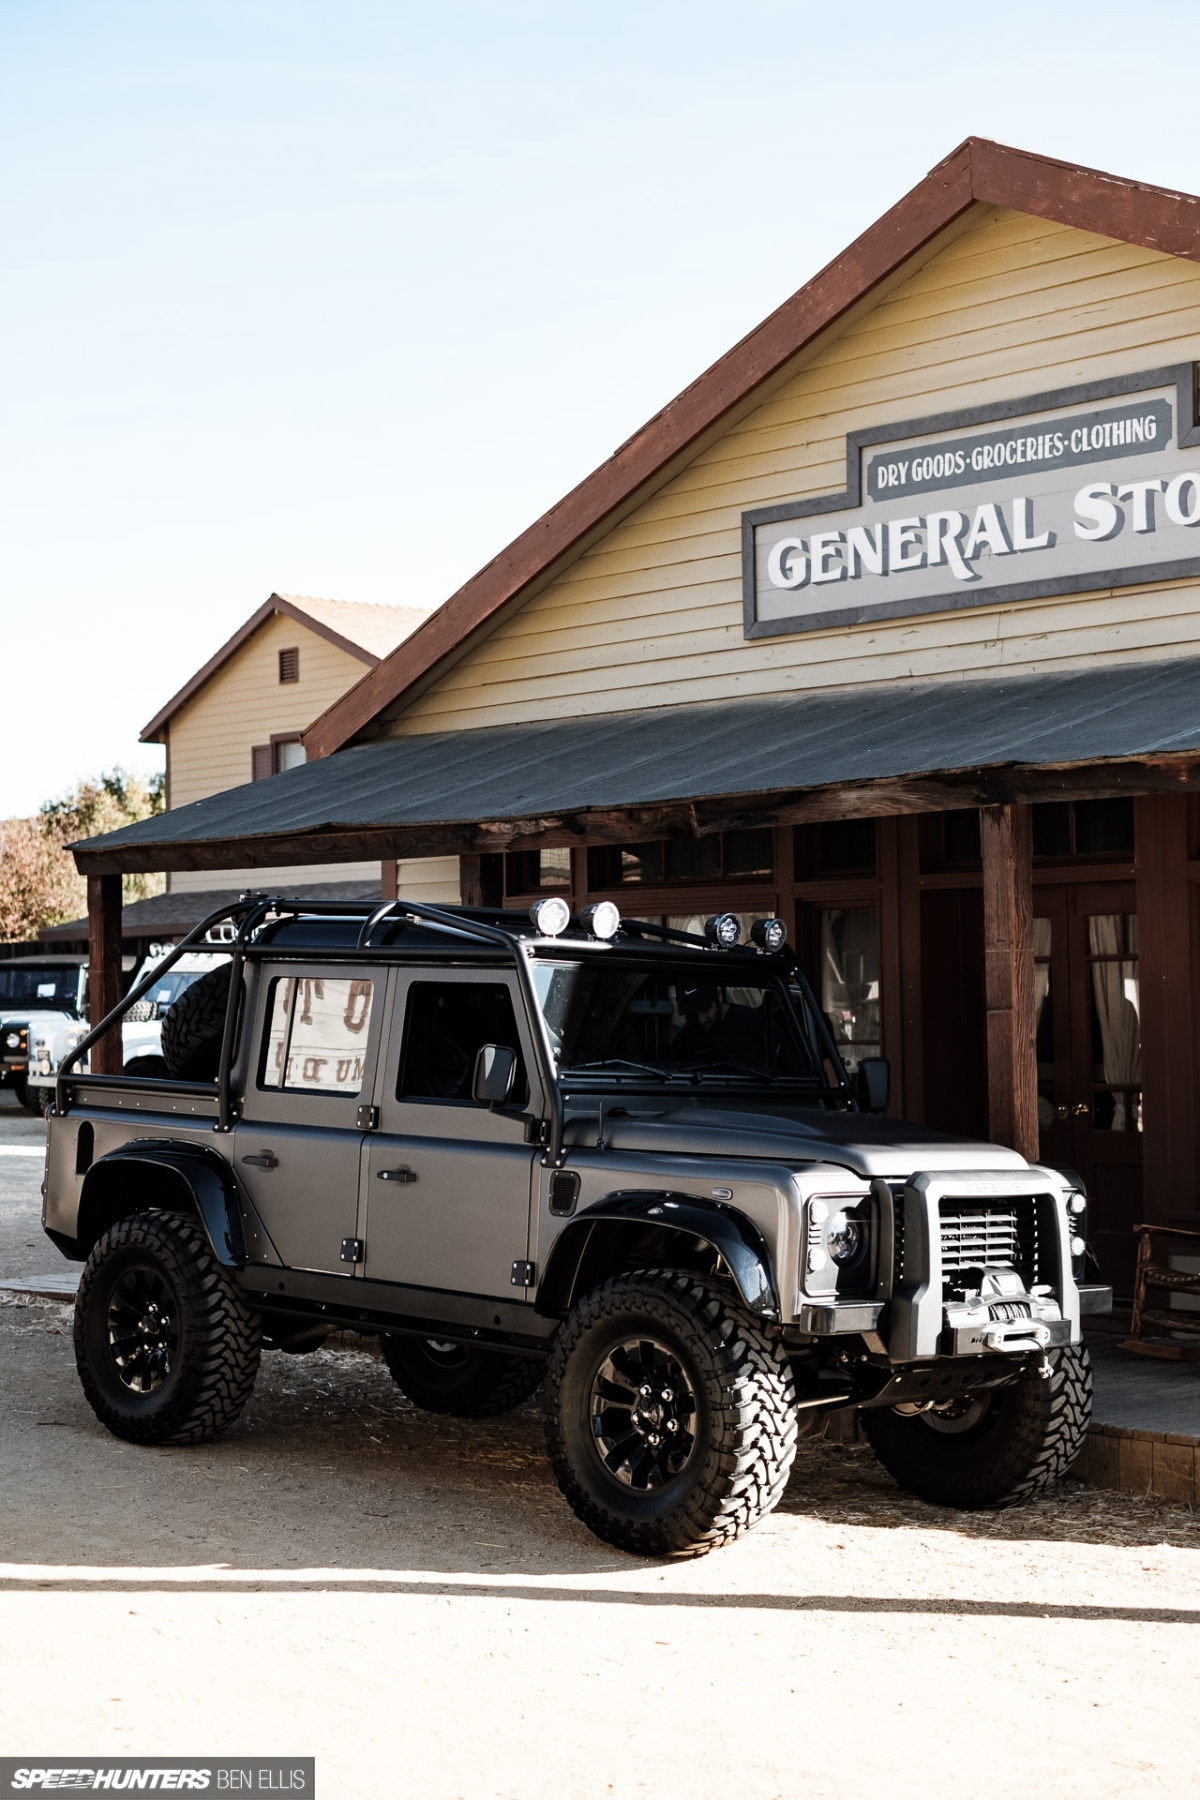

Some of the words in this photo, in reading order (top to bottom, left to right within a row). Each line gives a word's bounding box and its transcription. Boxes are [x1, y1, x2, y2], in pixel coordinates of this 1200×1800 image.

[877, 461, 910, 490] DRY
[911, 450, 966, 482] GOODS
[971, 431, 1064, 472] GROCERIES
[1070, 414, 1157, 454] CLOTHING
[767, 497, 1057, 590] GENERAL
[1073, 472, 1200, 543] STO
[965, 1182, 1030, 1194] DEFENDER
